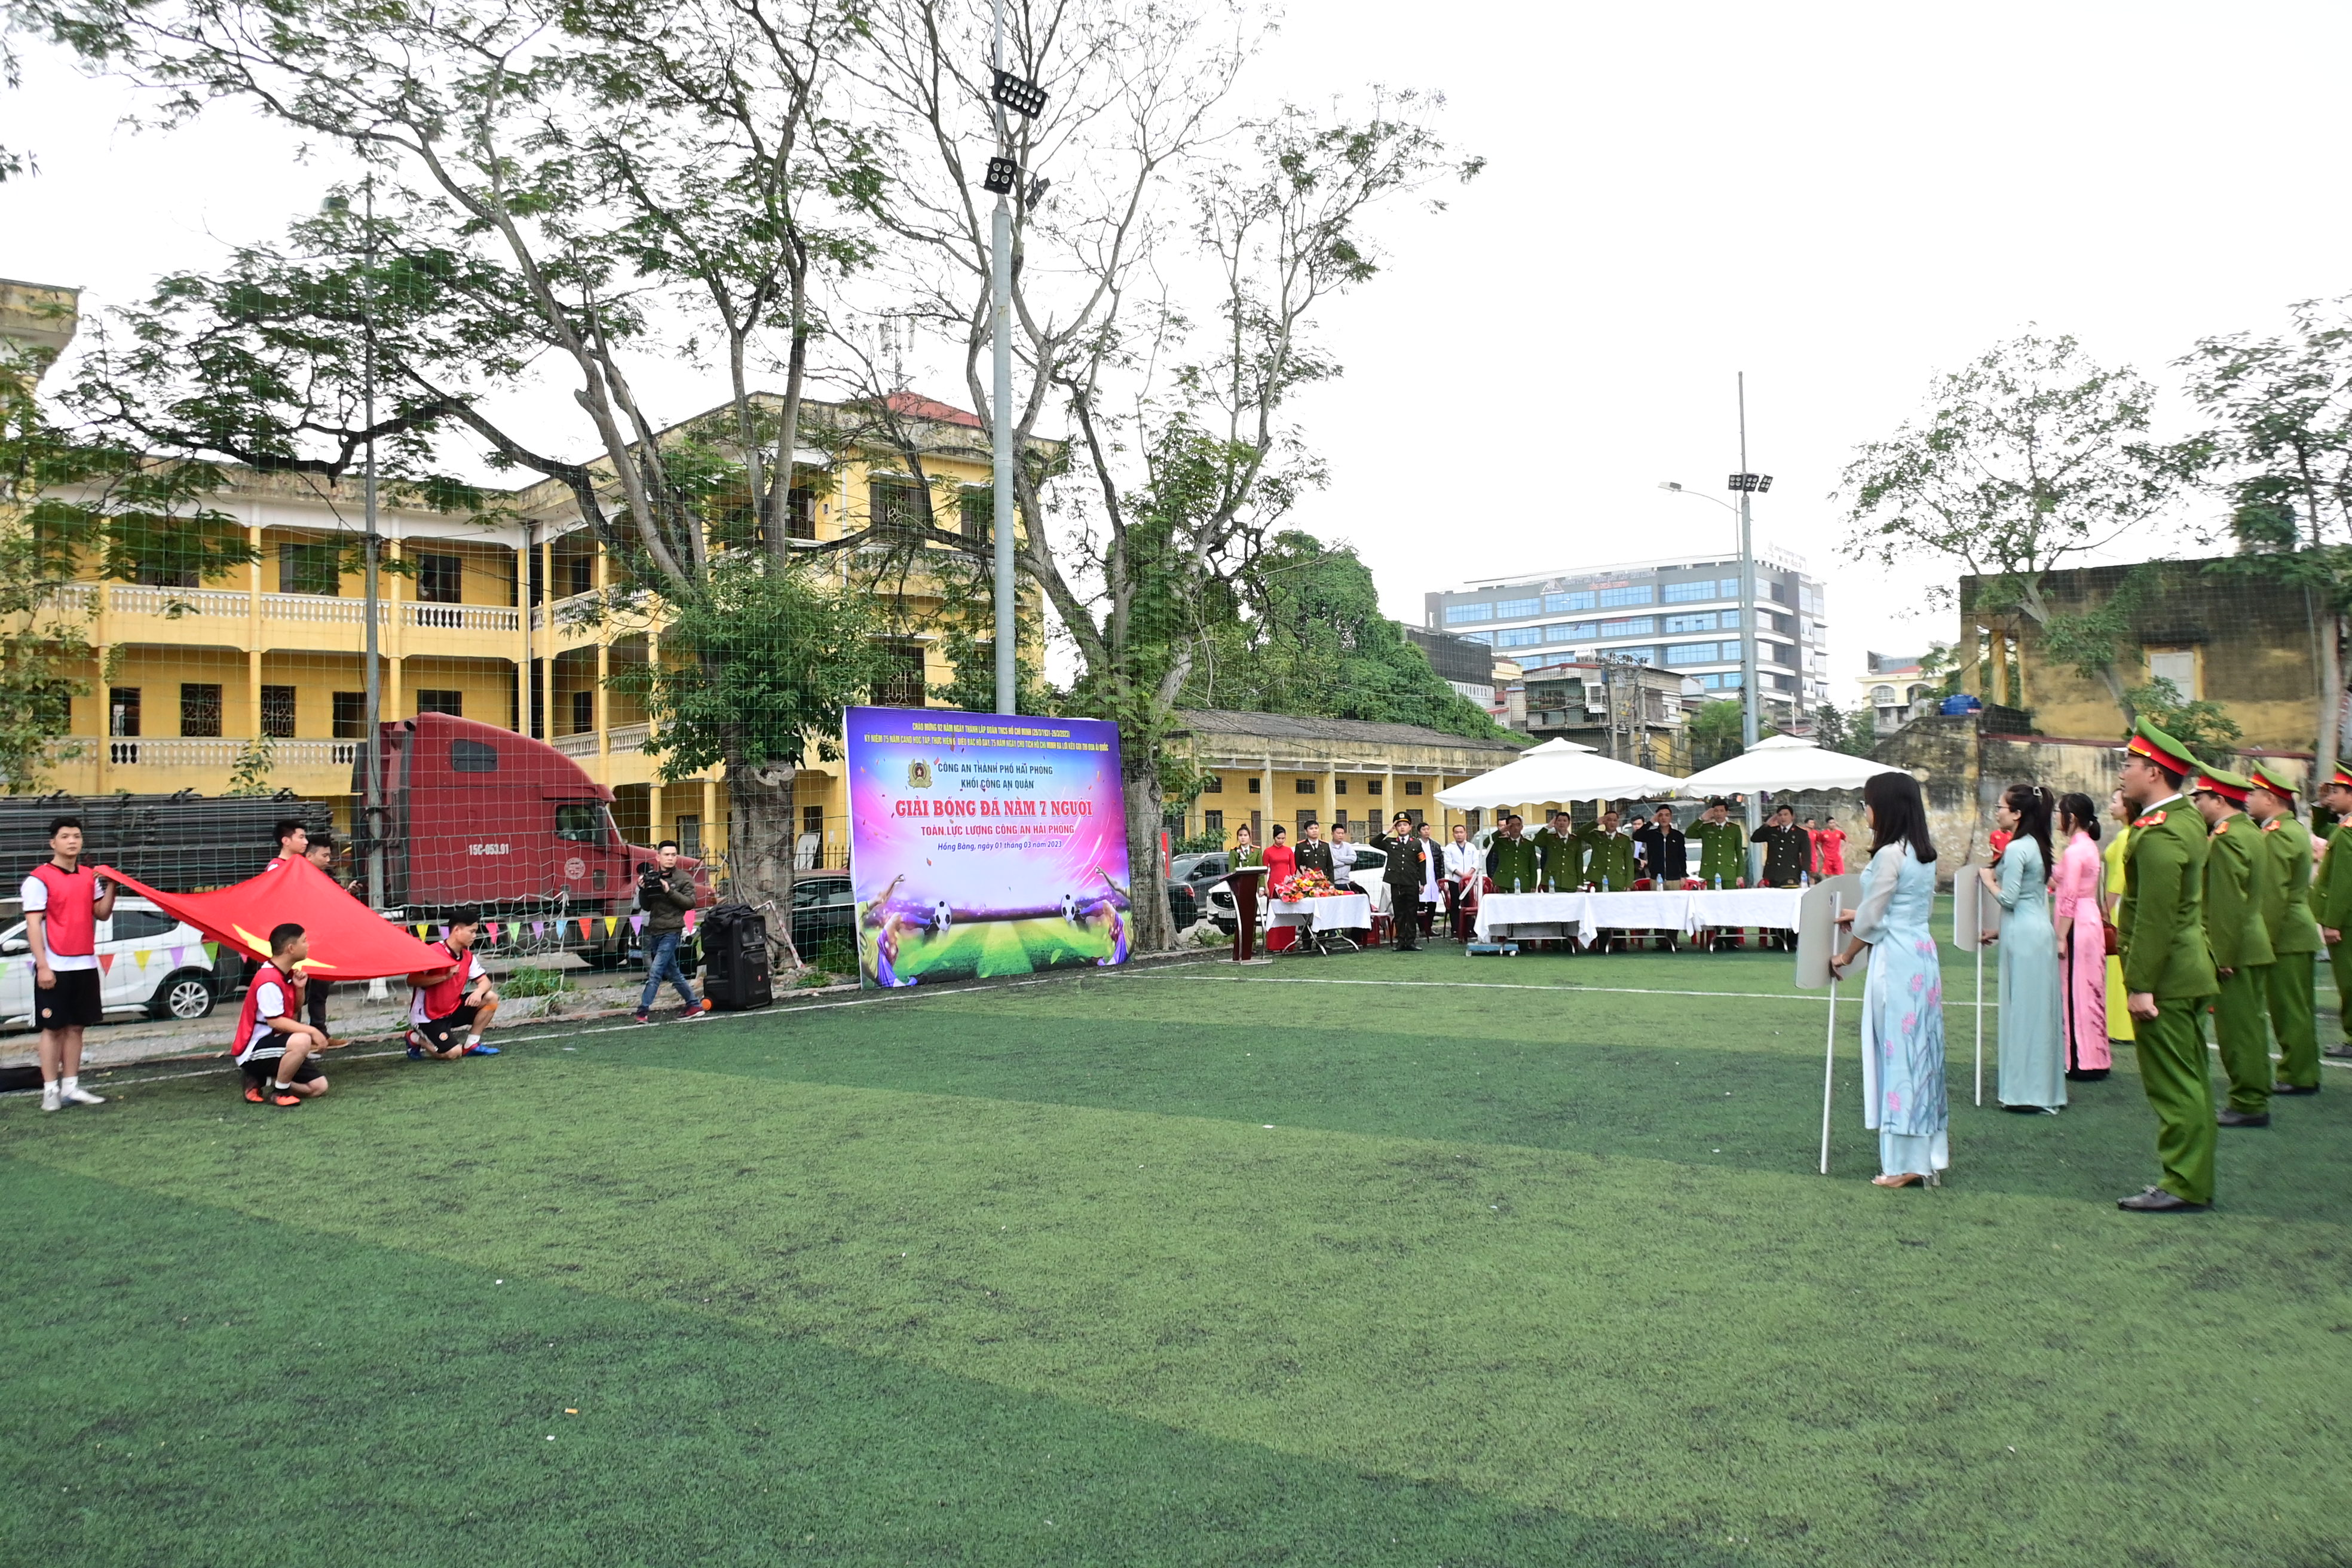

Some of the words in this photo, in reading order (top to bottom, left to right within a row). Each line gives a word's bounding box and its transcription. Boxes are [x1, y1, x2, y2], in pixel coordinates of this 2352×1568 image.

[938, 762, 958, 773] CÔNG
[961, 764, 972, 773] AN
[973, 762, 997, 773] THÀNH
[1000, 761, 1013, 773] PHỐ
[1016, 762, 1028, 774] HẢI
[1030, 764, 1053, 774] PHÒNG
[961, 776, 978, 788] KHỐI
[981, 777, 1000, 788] CÔNG
[1003, 779, 1013, 789] AN
[1015, 779, 1034, 790] QUẬN
[896, 795, 930, 817] GIẢI
[933, 796, 976, 817] BÓNG
[981, 796, 1000, 816] ĐÁ
[1040, 801, 1048, 816] 7
[1051, 797, 1094, 816] NGƯỜI
[921, 825, 944, 836] TOÀN
[947, 826, 963, 838] LỰC
[966, 825, 993, 837] LƯỢNG
[995, 823, 1018, 835] CÔNG
[1020, 825, 1031, 834] AN
[1033, 822, 1046, 834] HẢI
[1049, 823, 1074, 834] PHÒNG
[468, 844, 509, 856] 15C-053.91
[938, 841, 956, 852] Hồng
[957, 841, 976, 852] Bàng,
[978, 842, 993, 851] ngày
[1004, 841, 1022, 850] tháng
